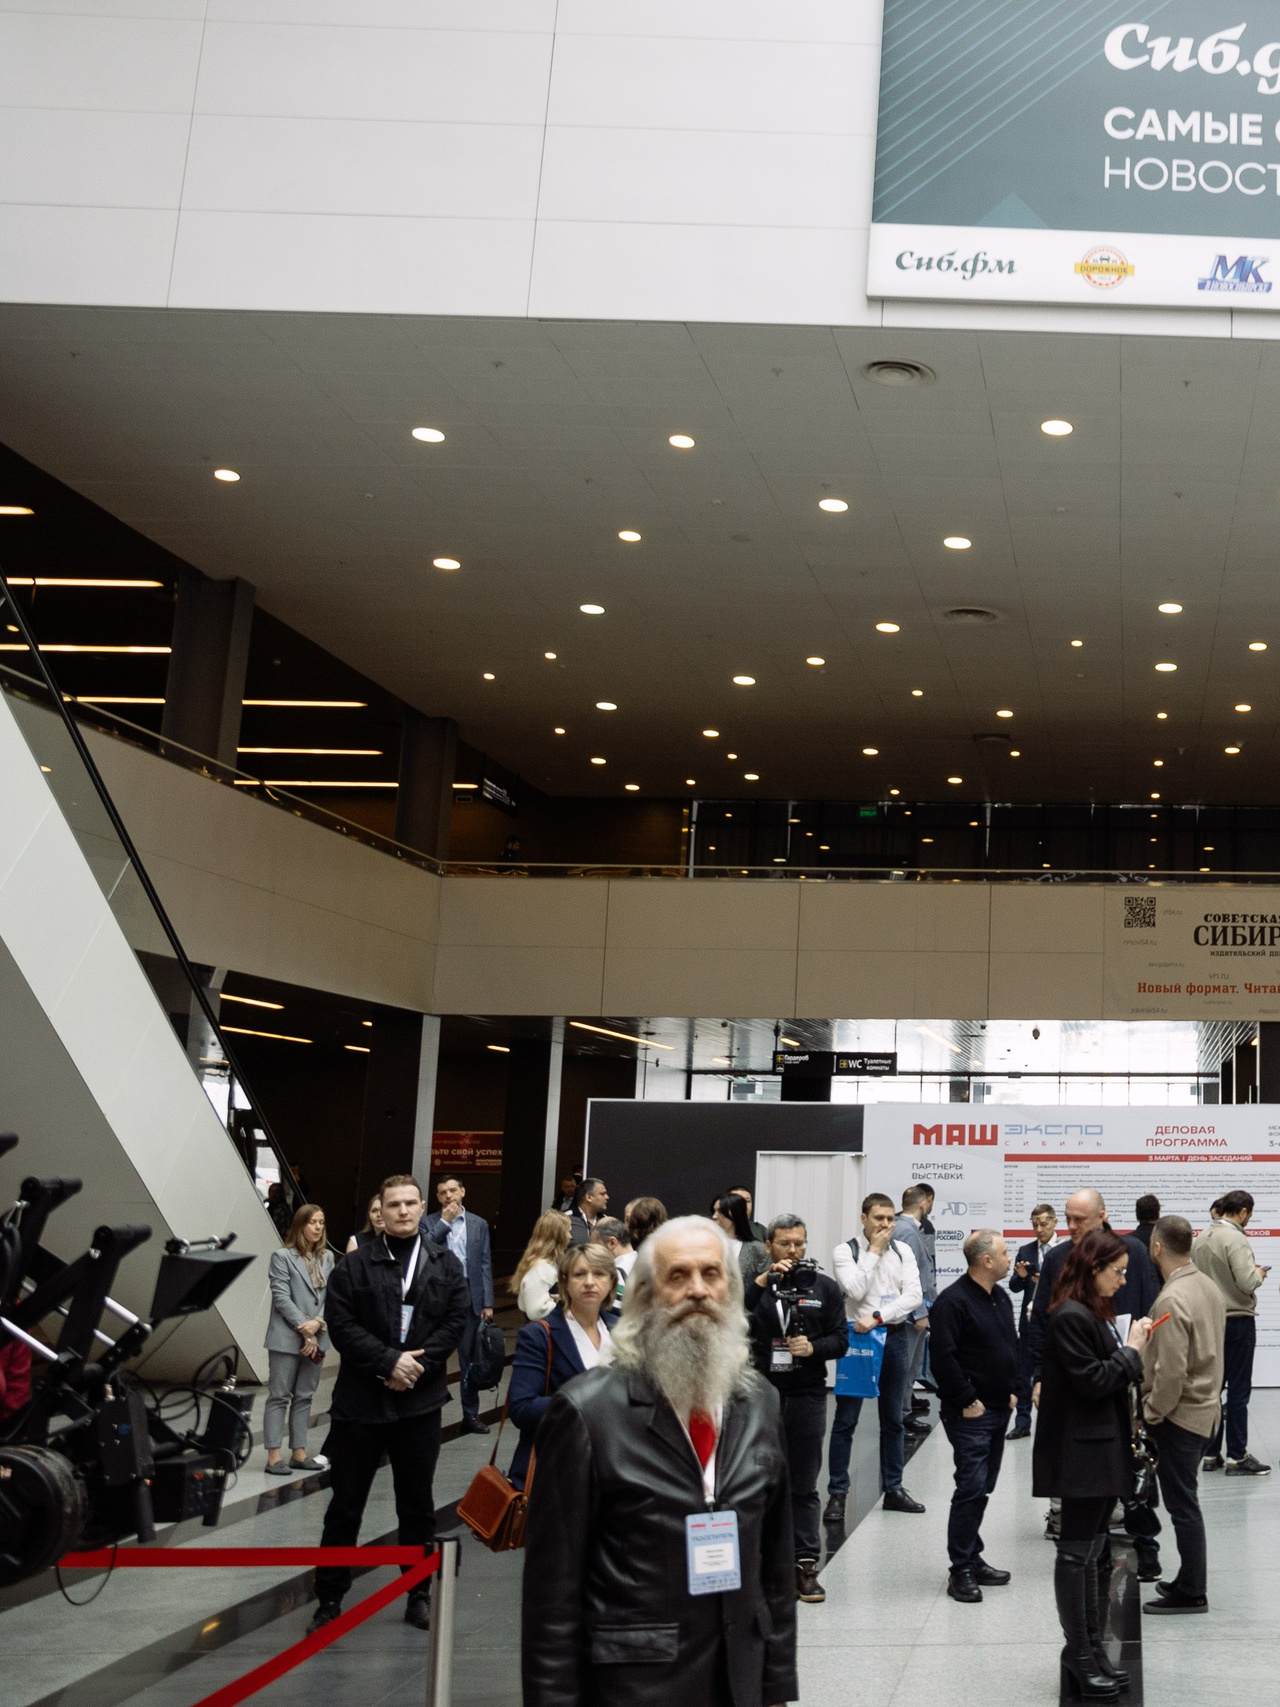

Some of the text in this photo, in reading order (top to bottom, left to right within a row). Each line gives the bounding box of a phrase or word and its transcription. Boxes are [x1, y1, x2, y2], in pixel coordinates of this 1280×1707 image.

[1103, 106, 1263, 145] САМЫЕ
[895, 250, 1017, 280] Сиб.фм
[1210, 254, 1271, 284] МК
[1137, 982, 1182, 994] Новый
[1186, 982, 1239, 996] формат.
[784, 1054, 809, 1062] Гардероб
[848, 1059, 863, 1069] WC
[913, 1124, 1104, 1146] МАШ ЭКСПО
[1154, 1125, 1216, 1136] ДЕЛОВАЯ
[1145, 1138, 1228, 1147] ПРОГРАММА
[475, 1149, 503, 1157] успех
[1208, 1154, 1253, 1162] ЗАСЕДАНИЙ
